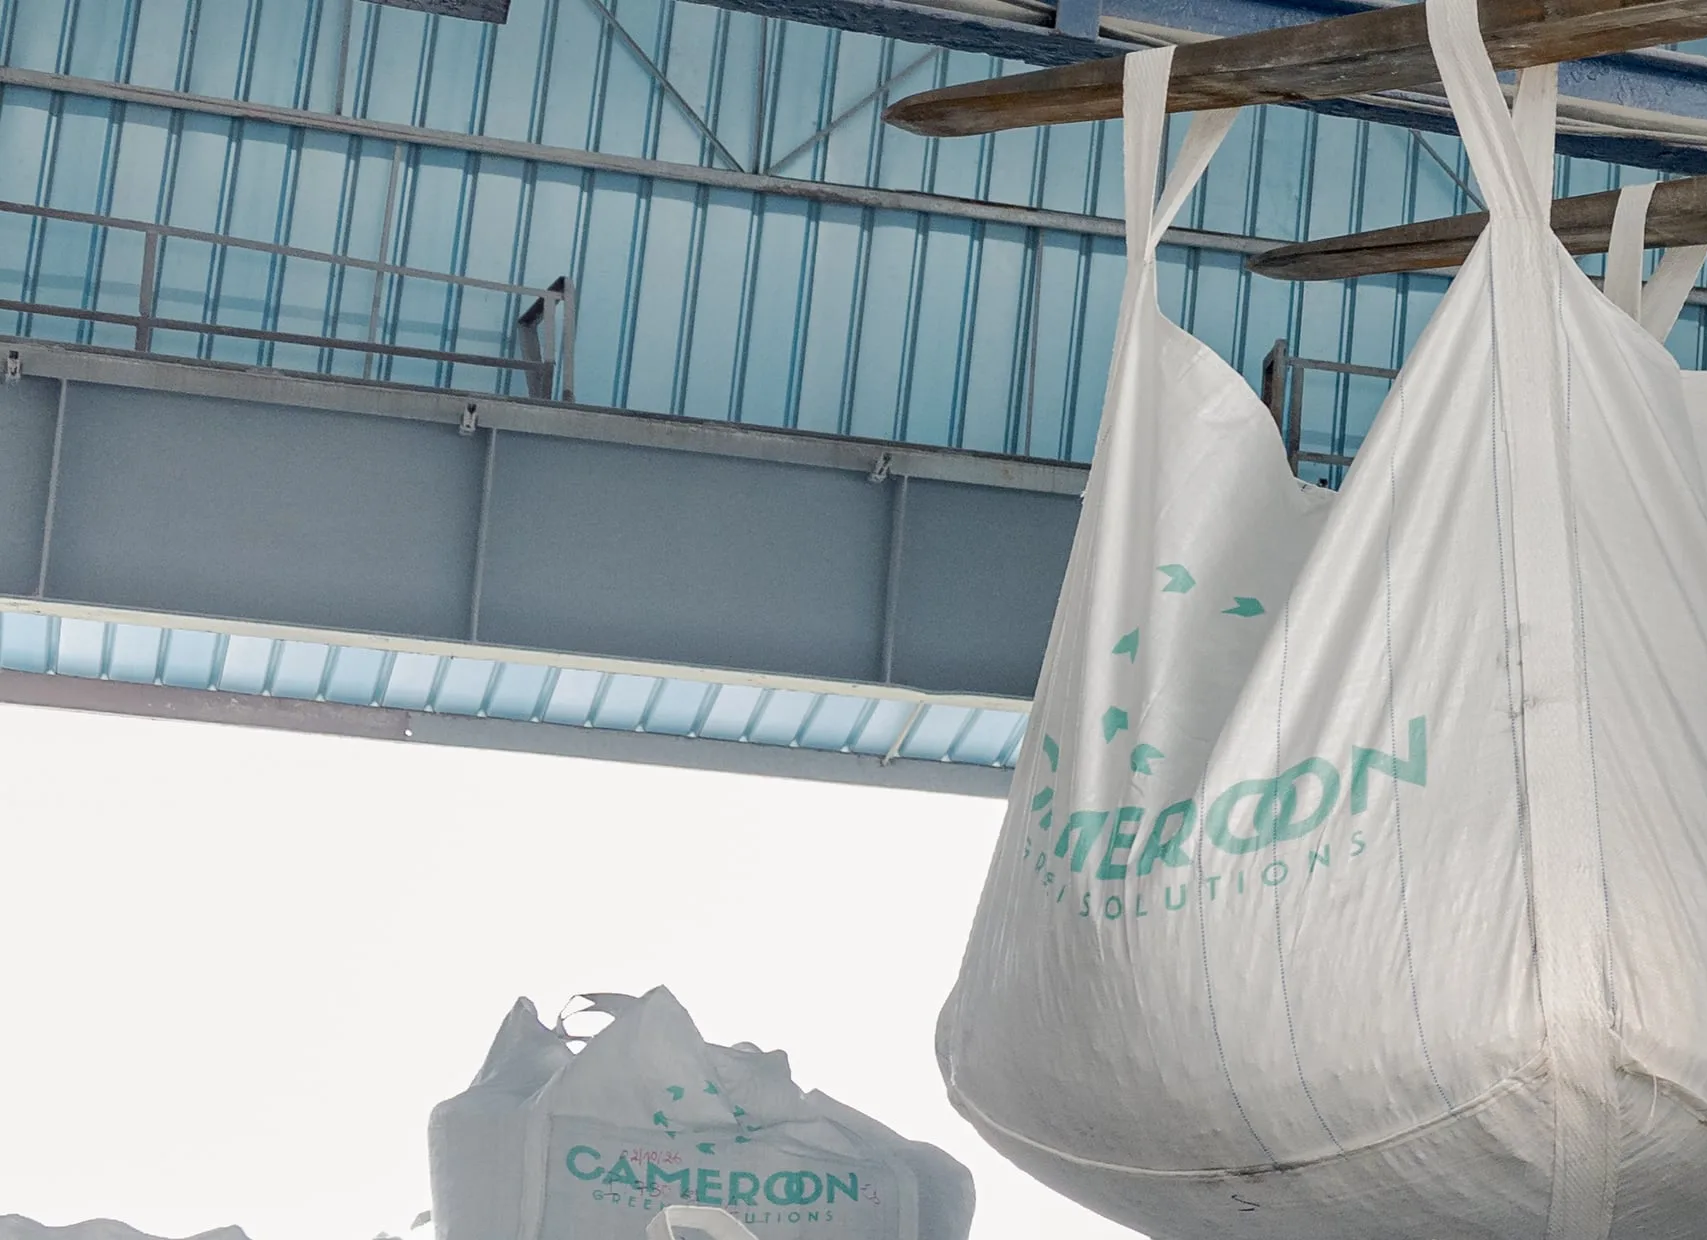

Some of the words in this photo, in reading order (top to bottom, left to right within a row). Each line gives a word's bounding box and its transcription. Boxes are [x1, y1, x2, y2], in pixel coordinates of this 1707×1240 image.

[1078, 829, 1367, 921] SOLUTIONS
[565, 1144, 860, 1207] CAMEROON
[744, 1211, 834, 1225] UTIONS
